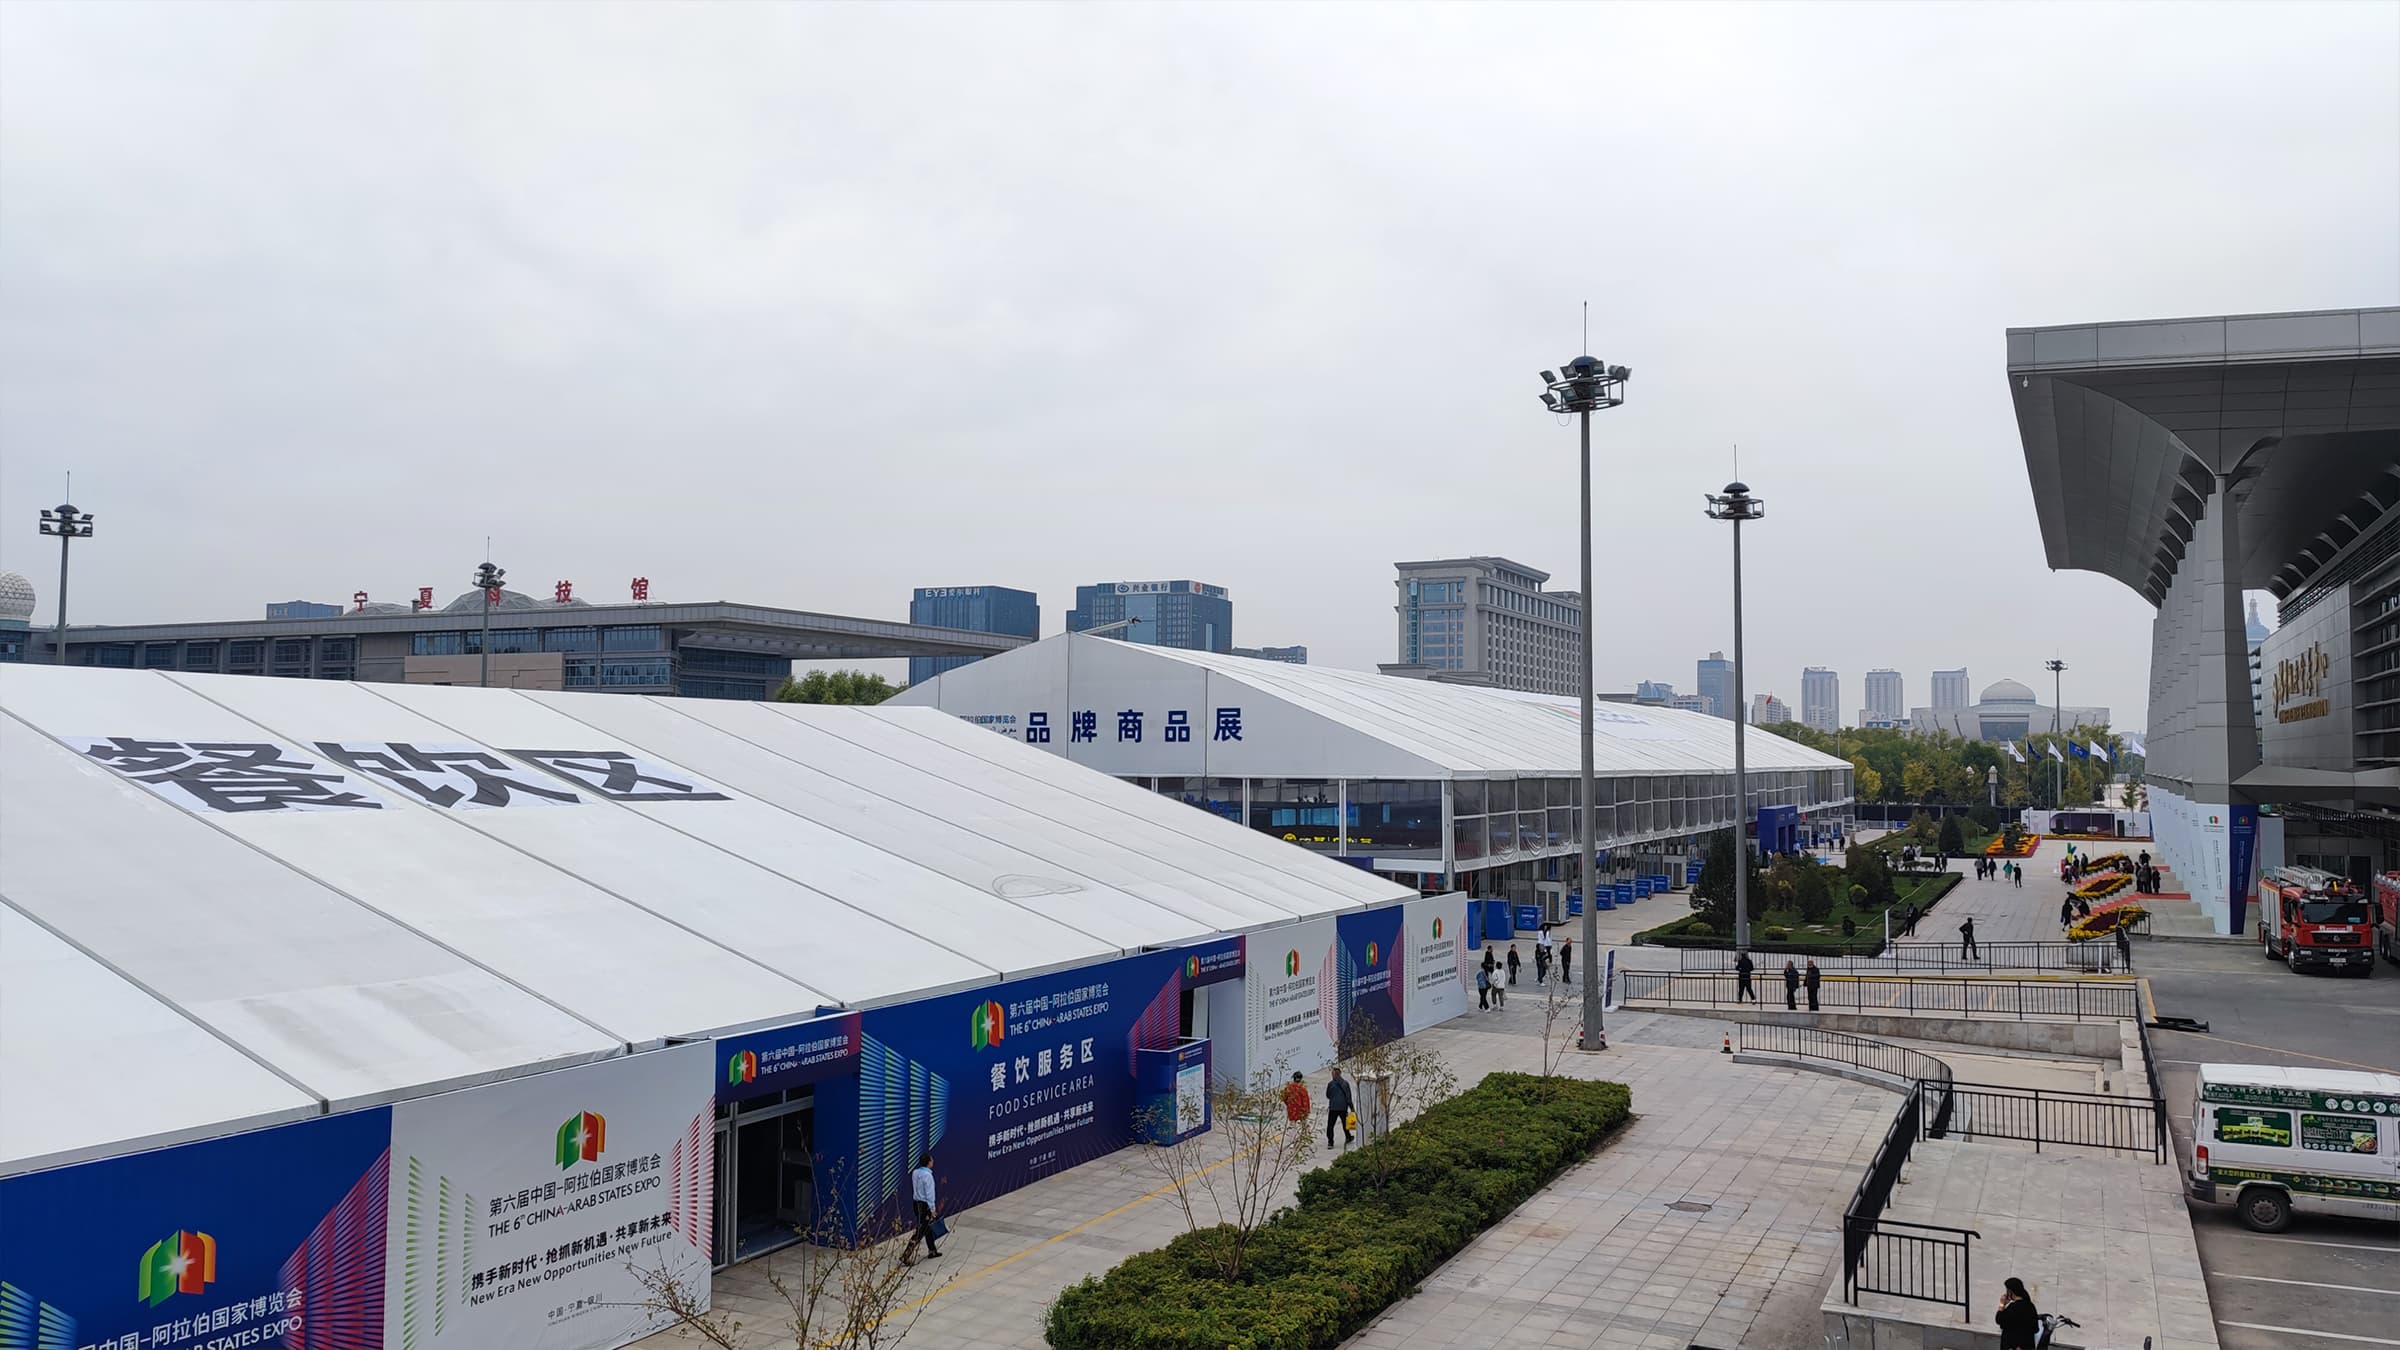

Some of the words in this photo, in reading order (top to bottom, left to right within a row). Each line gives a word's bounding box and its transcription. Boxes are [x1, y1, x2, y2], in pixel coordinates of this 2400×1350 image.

[1026, 707, 1243, 743] 品牌商品展
[86, 737, 735, 812] 餐饮区
[1010, 1024, 1023, 1037] THE
[1072, 1005, 1093, 1019] STATES
[1093, 1001, 1109, 1015] EXPO
[990, 1037, 1094, 1092] 餐饮服务区
[989, 1098, 1020, 1120] FOOD
[1022, 1082, 1067, 1109] SERVICE
[1069, 1074, 1094, 1094] AREA
[988, 1147, 1001, 1160] New
[1002, 1144, 1012, 1155] Era
[1013, 1140, 1025, 1151] New
[1065, 1121, 1076, 1132] New
[489, 1153, 661, 1217] 第六届中国-阿拉伯国家博览会
[489, 1220, 510, 1238] THE
[527, 1195, 597, 1228] CHINA-ARAB
[598, 1184, 633, 1204] STATES
[635, 1175, 661, 1194] EXPO
[470, 1291, 495, 1307] New
[497, 1282, 515, 1298] Era
[517, 1274, 541, 1291] New
[543, 1251, 616, 1282] Opportunities
[618, 1242, 640, 1255] New
[641, 1231, 672, 1247] Future
[263, 1315, 302, 1339] EXPO
